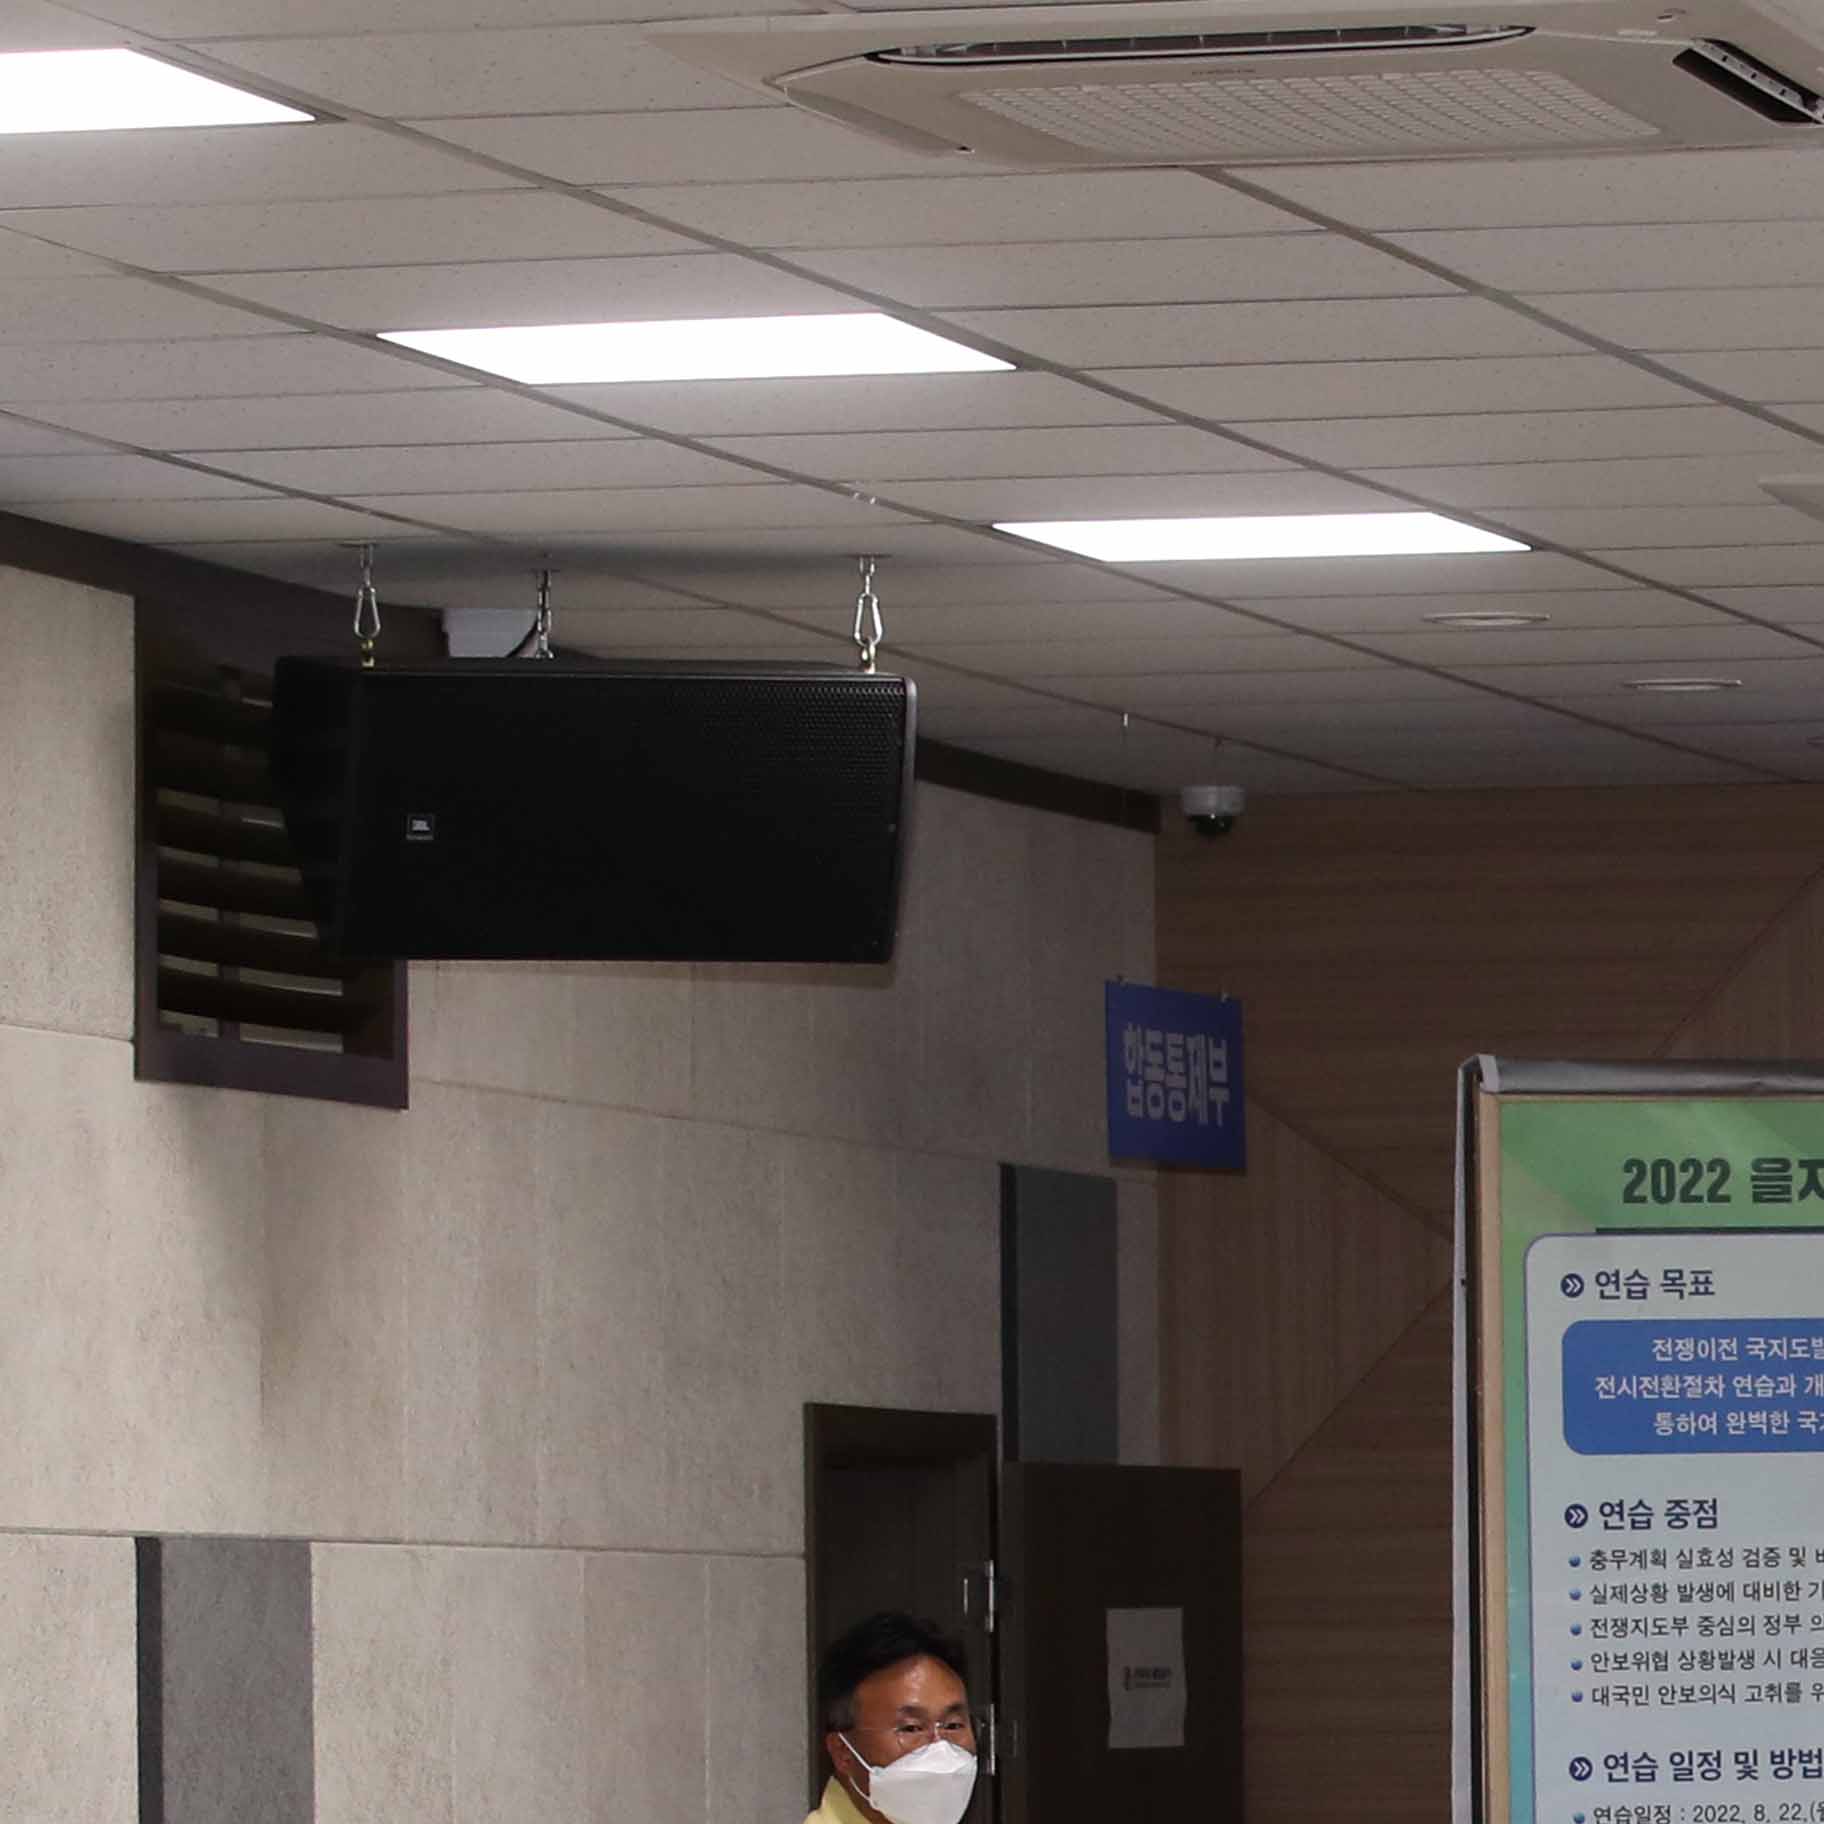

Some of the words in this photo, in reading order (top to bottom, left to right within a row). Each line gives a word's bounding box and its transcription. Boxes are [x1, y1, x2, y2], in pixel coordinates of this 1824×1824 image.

[1623, 1158, 1731, 1204] 2022
[1595, 1270, 1649, 1300] 연습
[1660, 1268, 1715, 1299] 목표
[1653, 1336, 1739, 1362] 전쟁이전
[1595, 1375, 1725, 1400] 전시전환절차
[1732, 1373, 1796, 1399] 연습과
[1653, 1411, 1719, 1437] 통하여
[1725, 1410, 1790, 1436] 완벽한
[1598, 1502, 1655, 1531] 연습
[1664, 1500, 1719, 1529] 중점
[1589, 1549, 1668, 1571] 충무계획
[1675, 1547, 1735, 1570] 실효성
[1741, 1546, 1782, 1569] 검증
[1788, 1546, 1808, 1568] 및
[1589, 1582, 1668, 1605] 실제상황
[1676, 1581, 1735, 1604] 발생에
[1742, 1580, 1802, 1602] 대비한
[1589, 1616, 1690, 1639] 전쟁지도부
[1697, 1614, 1756, 1637] 중심의
[1763, 1613, 1802, 1636] 정부
[1589, 1650, 1670, 1672] 안보위협
[1678, 1648, 1757, 1670] 상황발생
[1764, 1648, 1782, 1670] 시
[1591, 1683, 1650, 1706] 대국민
[1657, 1682, 1737, 1705] 안보의식
[1745, 1681, 1802, 1703] 고취를
[1603, 1752, 1659, 1782] 연습
[1668, 1751, 1722, 1781] 일정
[1733, 1750, 1760, 1780] 및
[1768, 1748, 1824, 1779] 방법
[1692, 1804, 1746, 1824] 2022.
[1753, 1803, 1773, 1824] 8.
